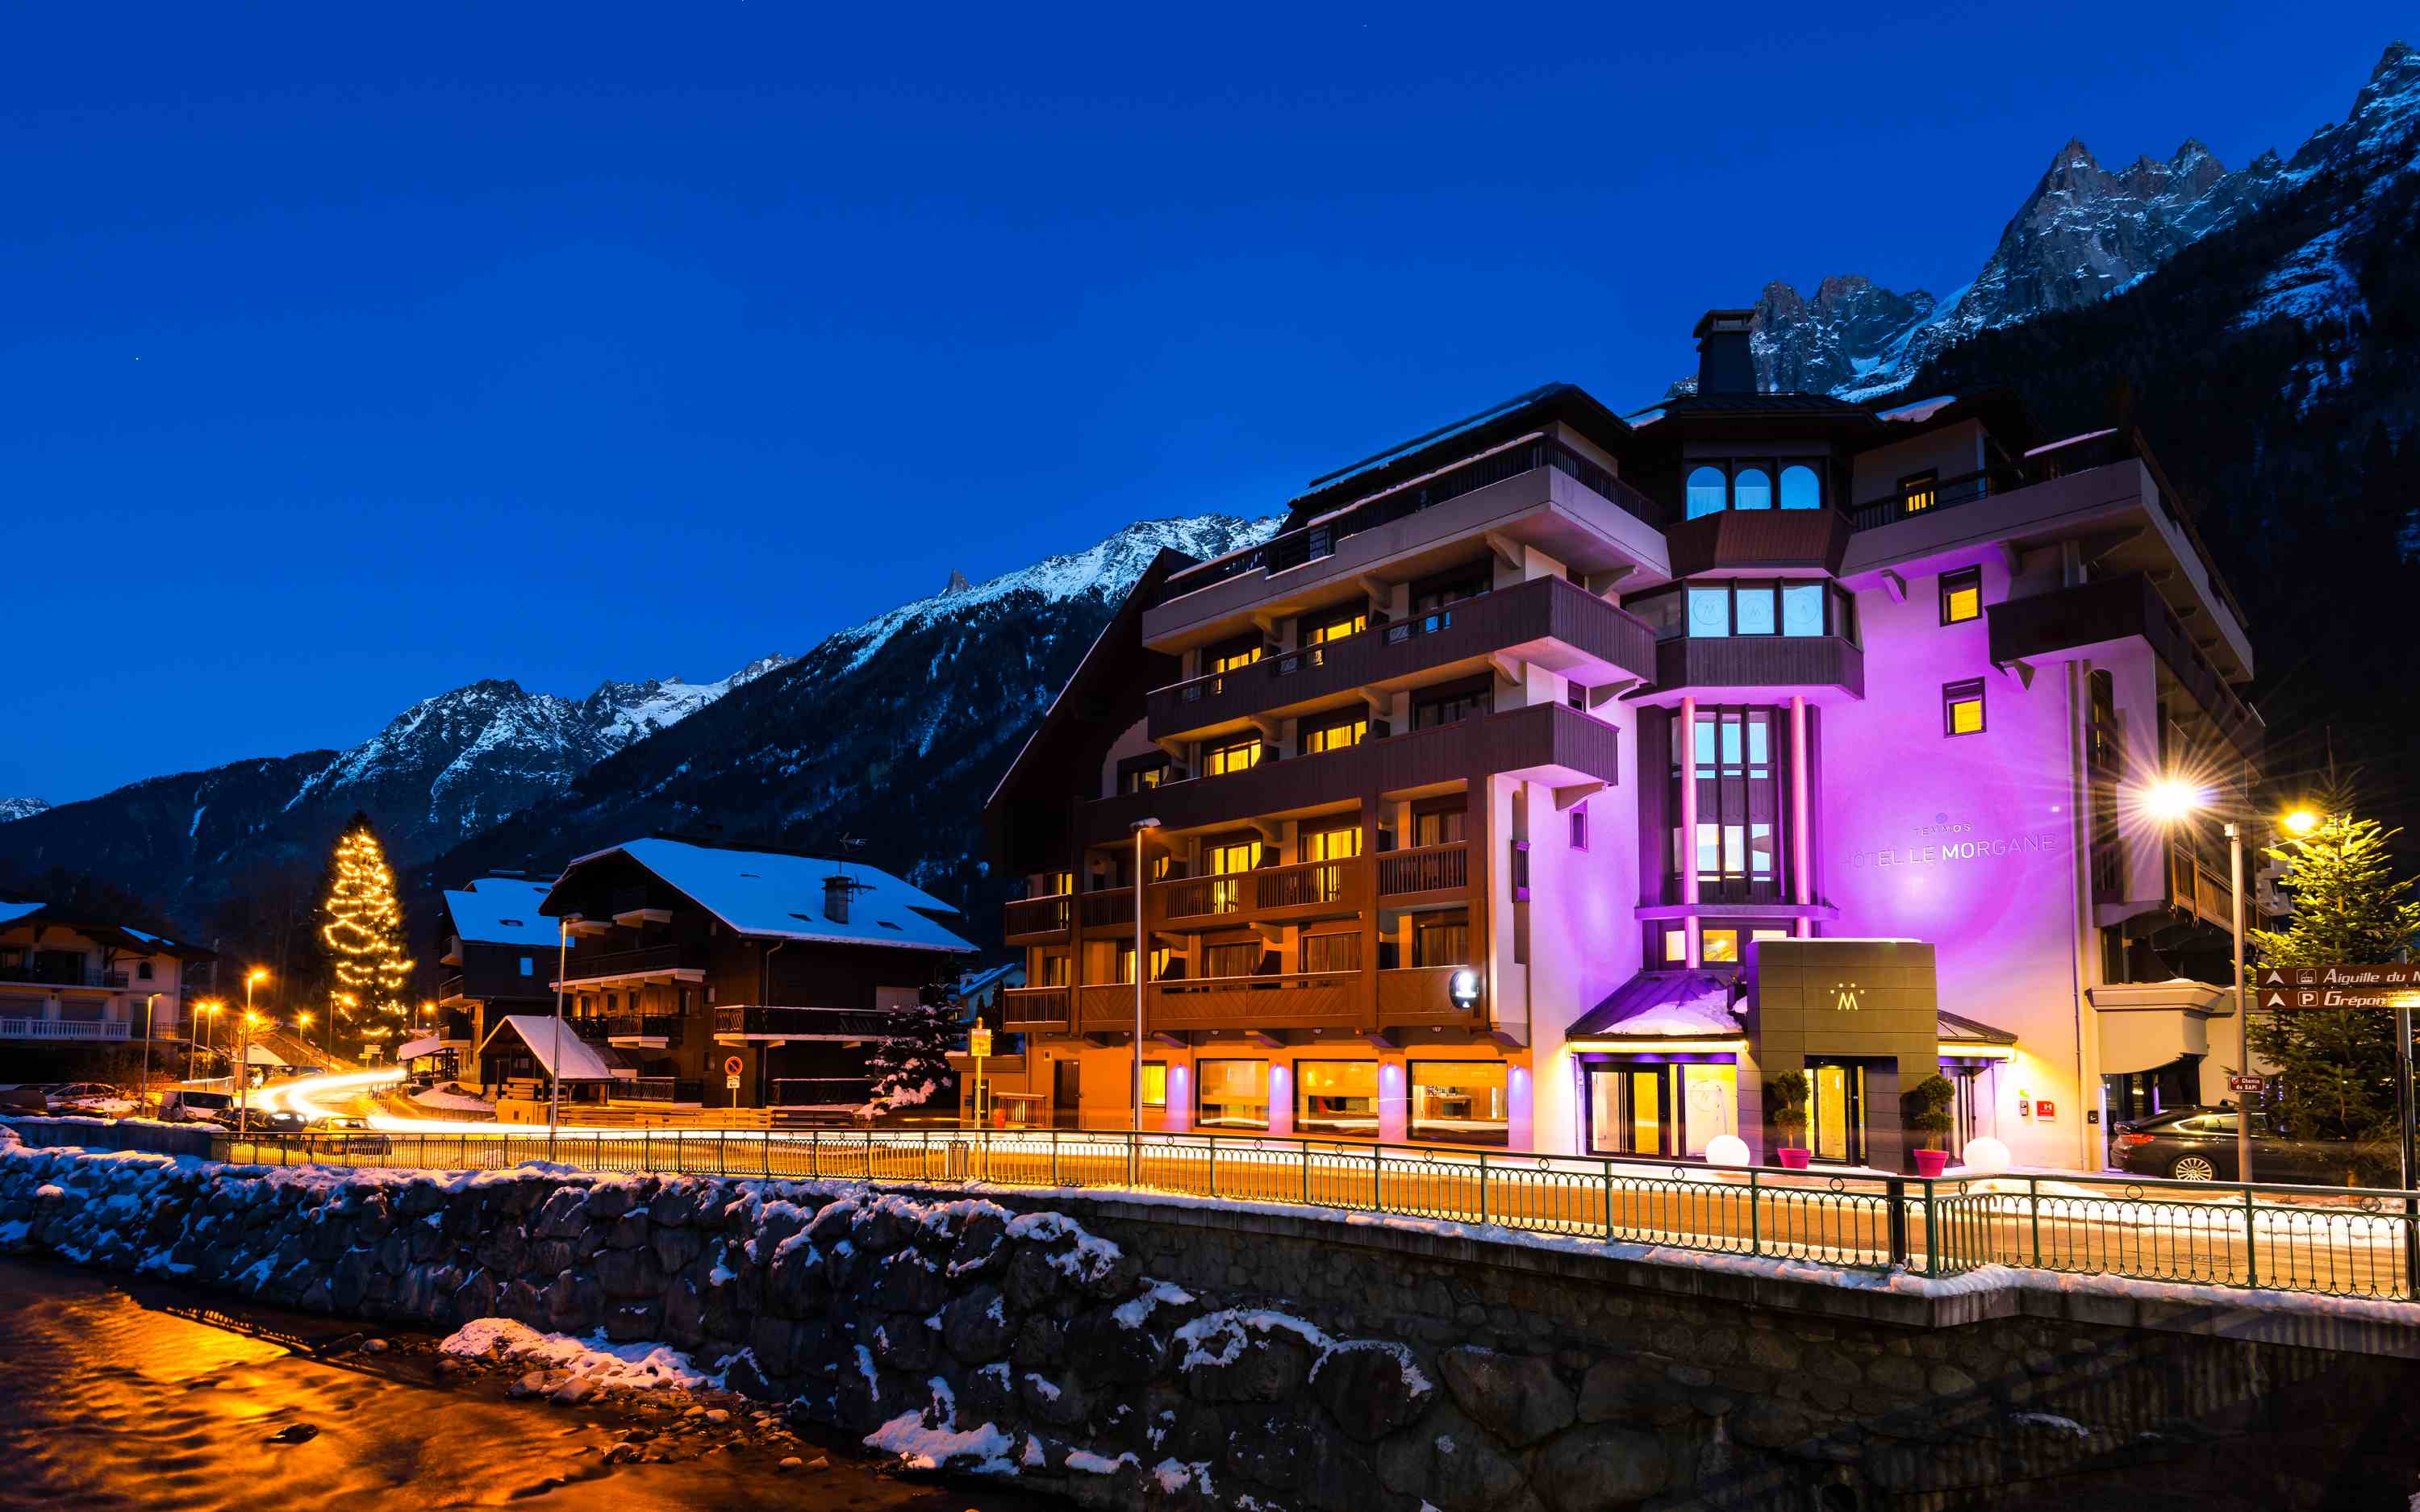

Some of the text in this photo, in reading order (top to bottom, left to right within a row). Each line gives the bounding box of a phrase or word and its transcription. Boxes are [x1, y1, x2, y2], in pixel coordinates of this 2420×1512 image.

[1909, 846, 1936, 864] LE
[1942, 833, 2056, 861] MORGANE
[2323, 968, 2380, 985] Aiguille
[2386, 971, 2406, 982] du
[1838, 992, 1859, 1010] M
[2302, 993, 2314, 1005] P
